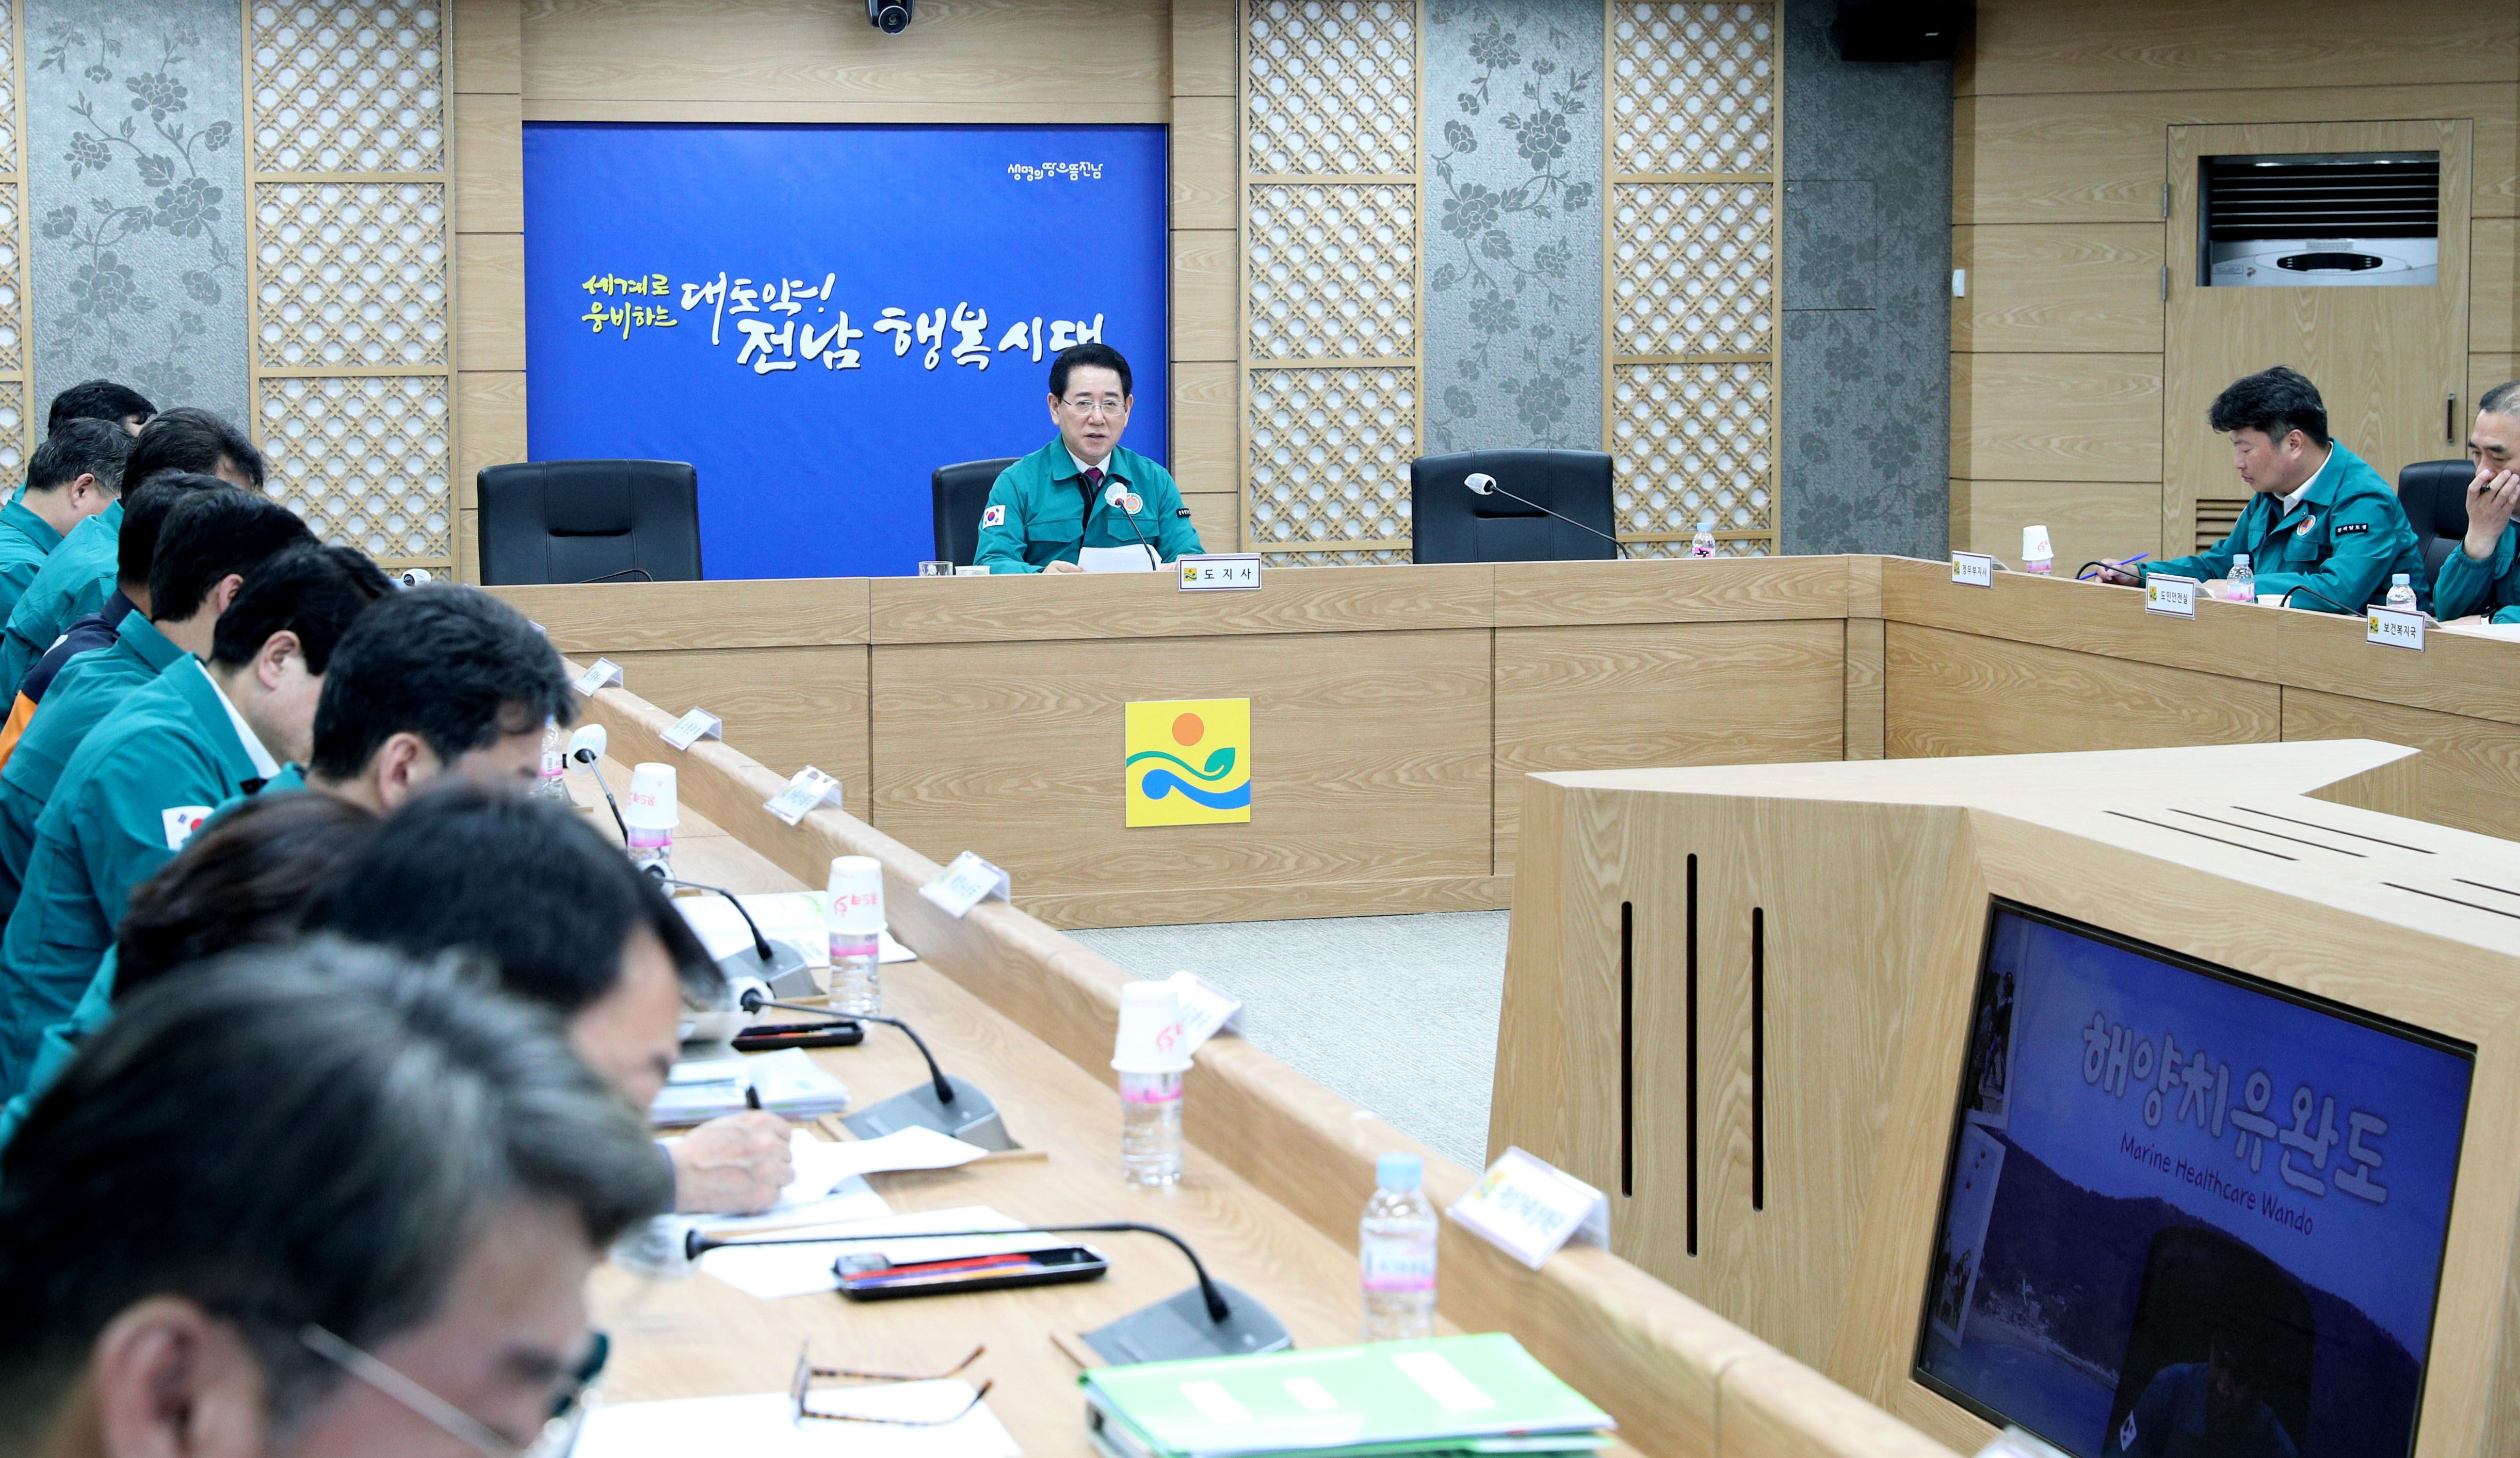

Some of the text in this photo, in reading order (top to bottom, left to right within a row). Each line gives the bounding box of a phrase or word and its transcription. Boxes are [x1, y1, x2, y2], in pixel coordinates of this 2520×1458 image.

[581, 273, 670, 296] 세계로
[581, 301, 678, 340] 웅비하는
[681, 271, 836, 345] 대도약!
[737, 311, 864, 375] 전남
[1962, 564, 1987, 577] 정무부지사
[2160, 591, 2188, 604] 도민안전실
[2384, 622, 2416, 639] 보건복지국
[2120, 1132, 2314, 1236] Marine Healthcare Wando
